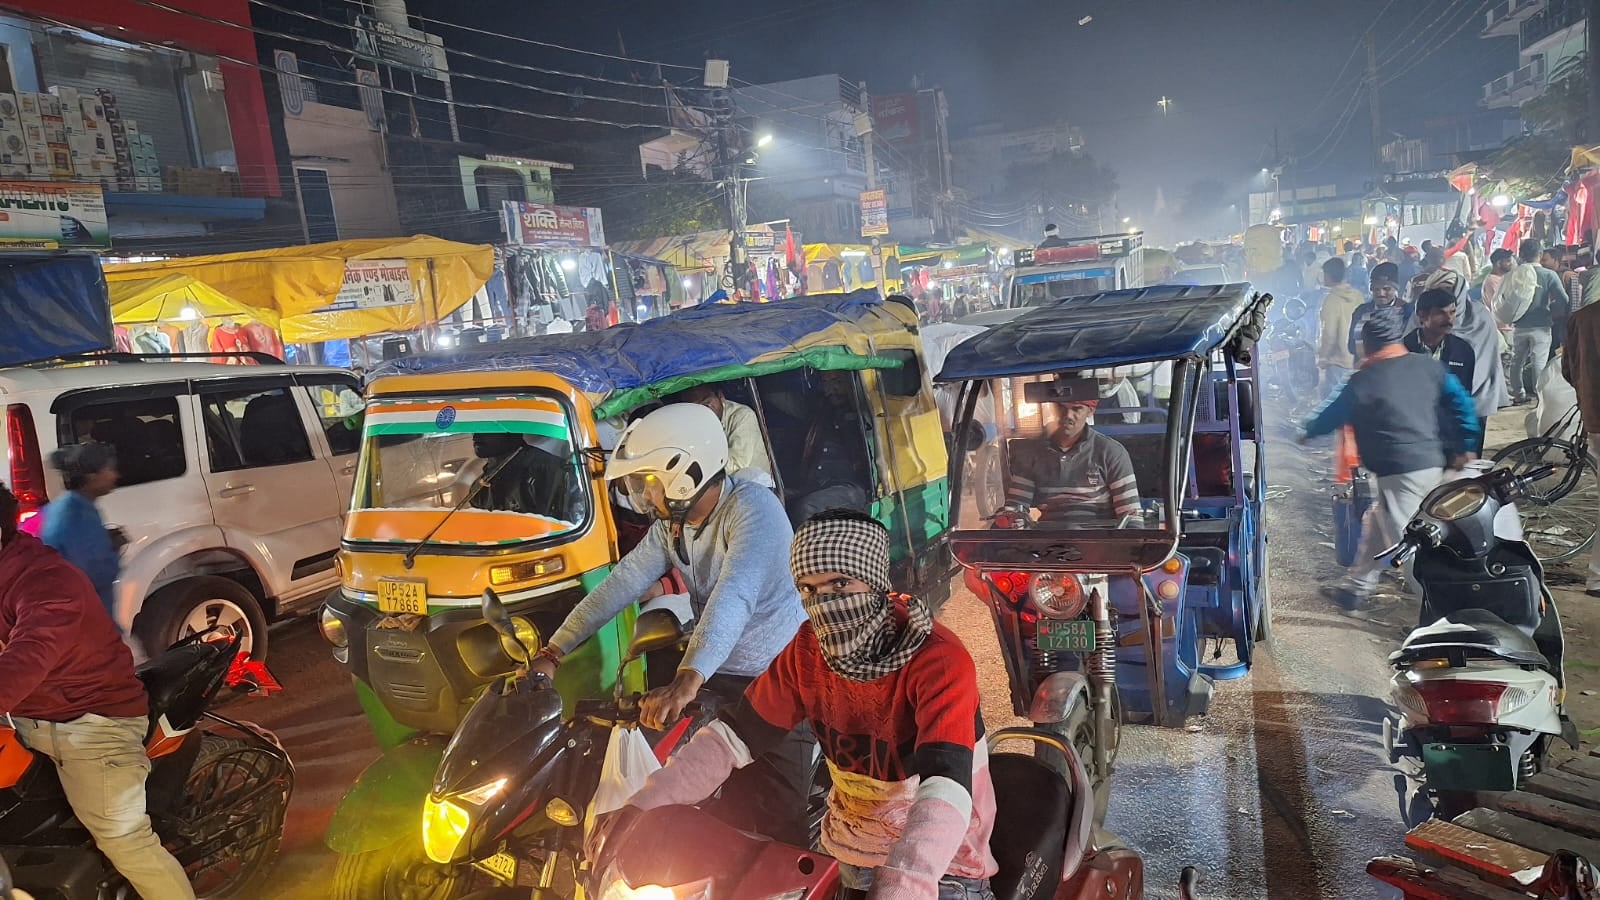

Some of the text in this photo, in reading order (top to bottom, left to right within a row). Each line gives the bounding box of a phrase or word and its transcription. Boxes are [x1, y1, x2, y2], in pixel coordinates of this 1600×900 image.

[524, 209, 558, 229] शक्ति
[362, 268, 380, 282] एण्ड
[380, 264, 409, 282] मोबाइल
[385, 583, 417, 597] UP52A
[386, 597, 419, 612] T7866
[1046, 621, 1087, 635] UP58A
[1048, 635, 1088, 649] T2130
[811, 719, 906, 781] H&M
